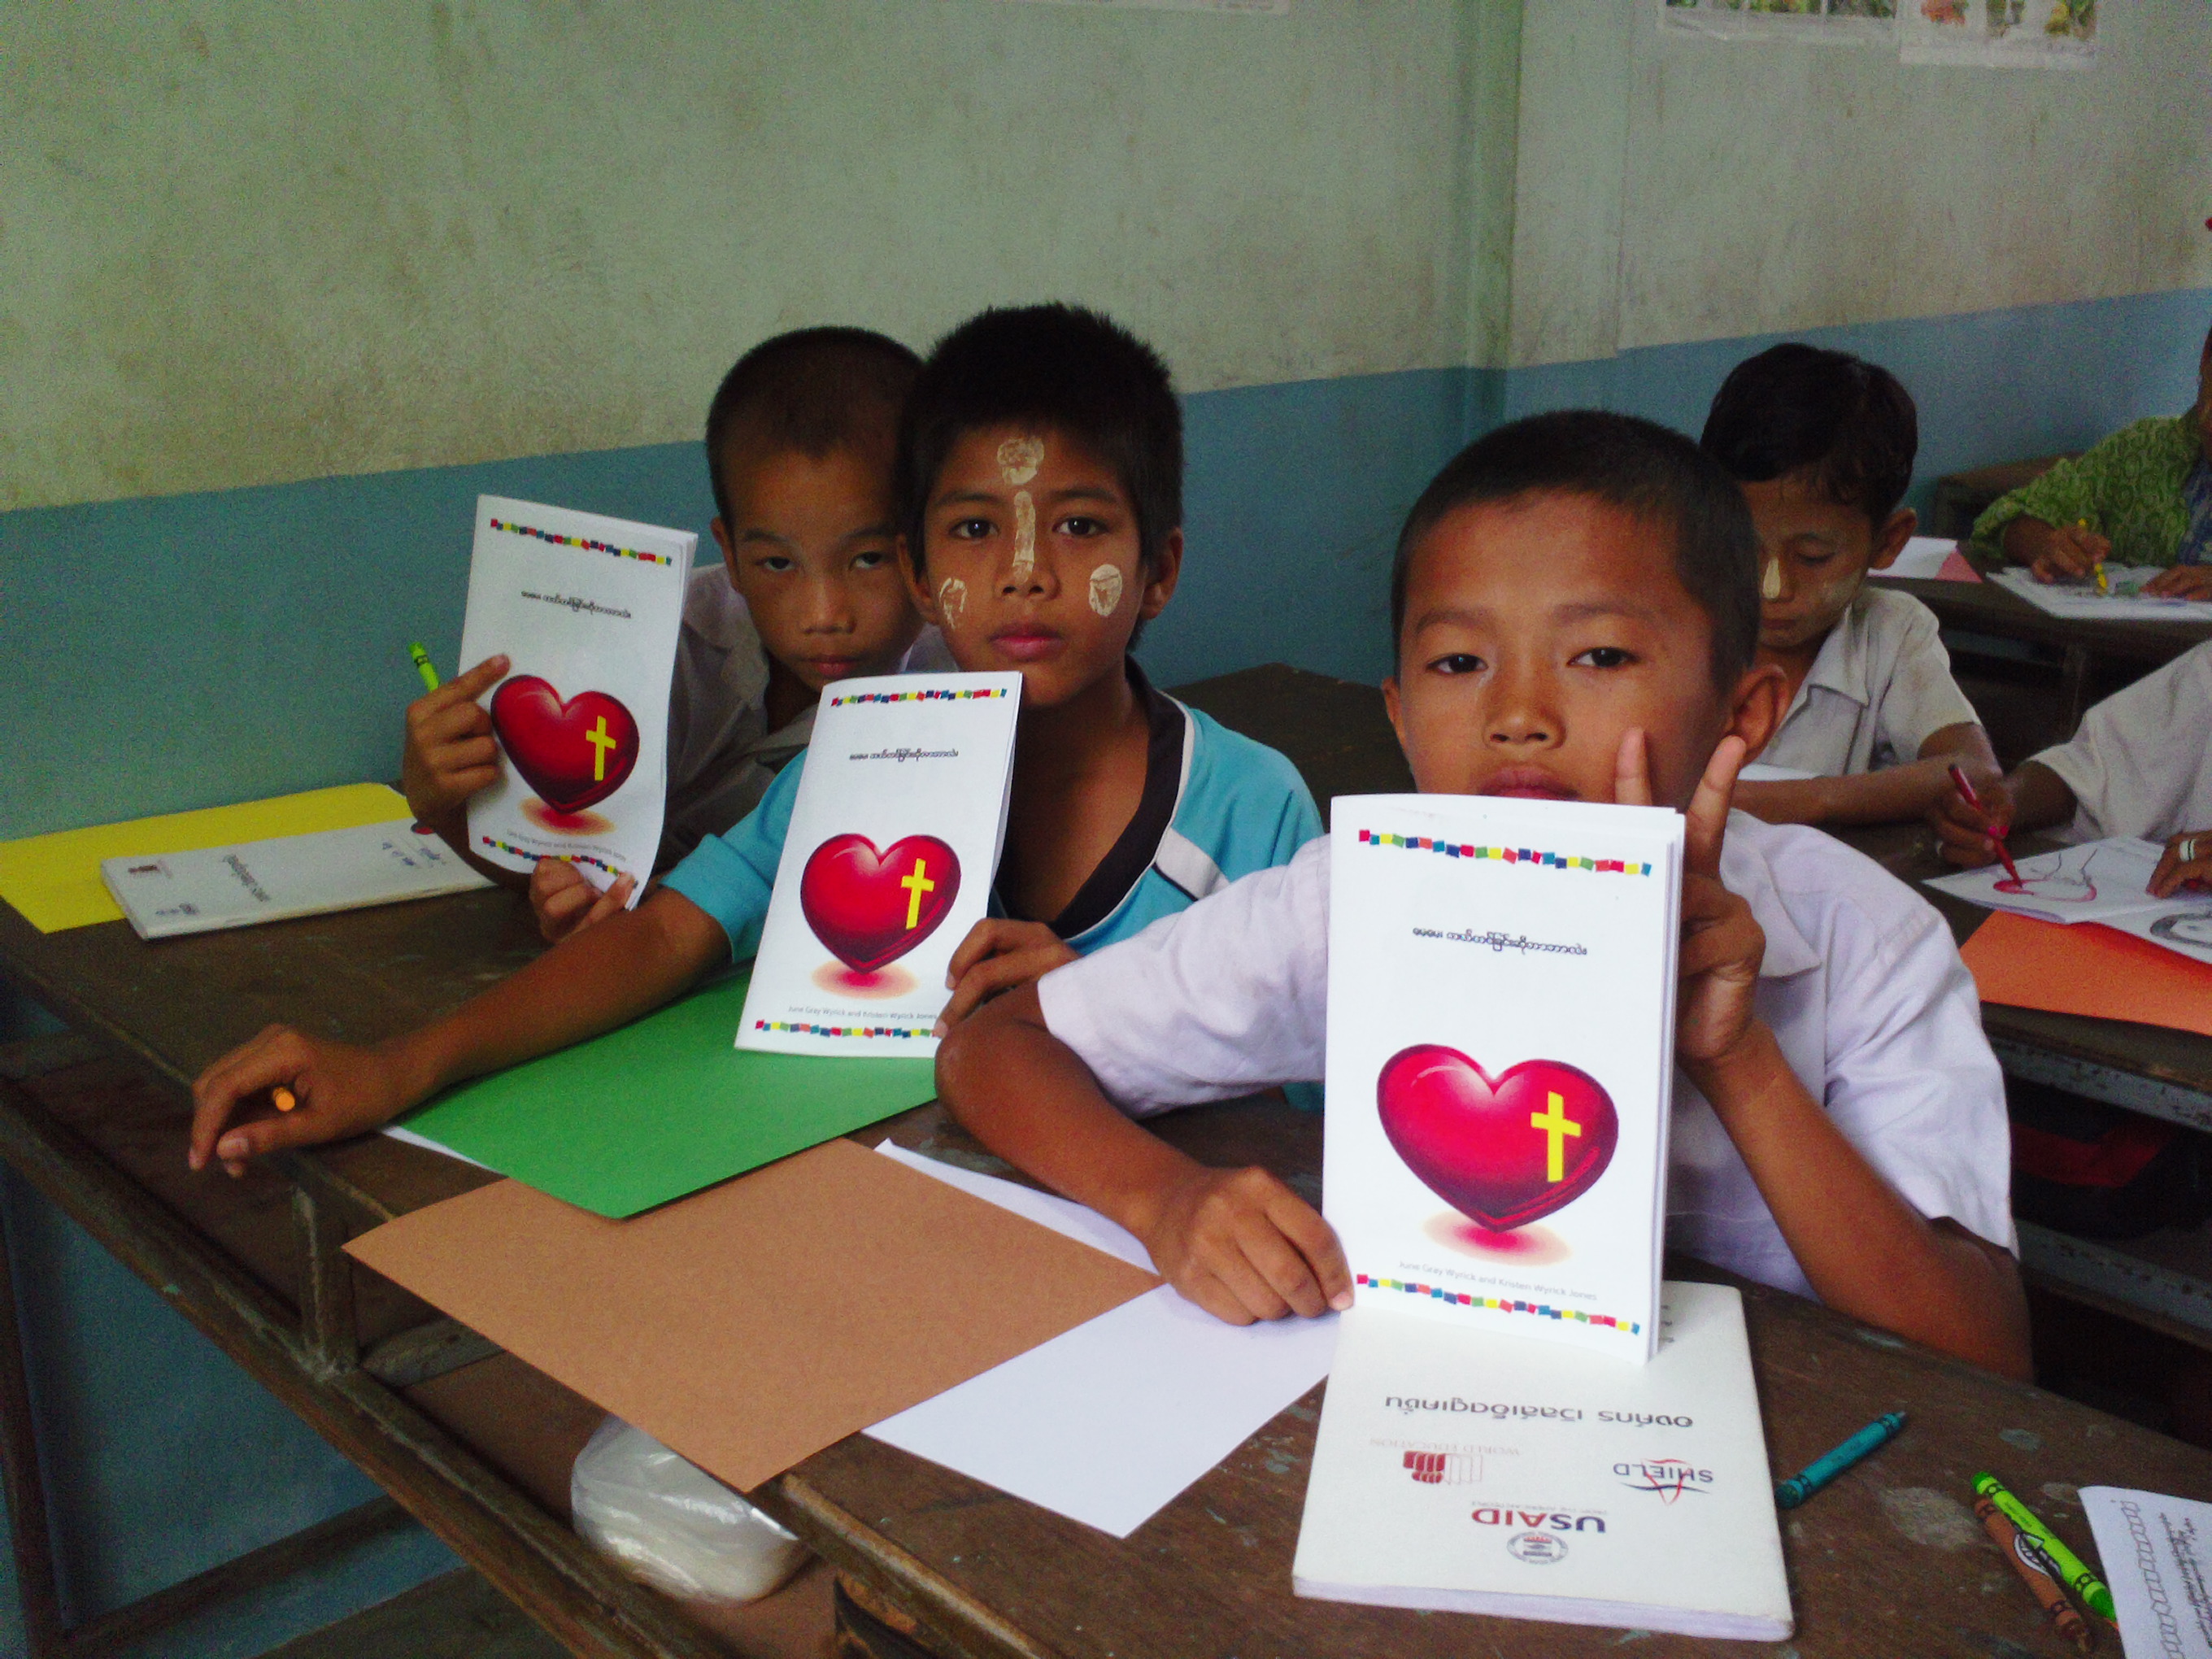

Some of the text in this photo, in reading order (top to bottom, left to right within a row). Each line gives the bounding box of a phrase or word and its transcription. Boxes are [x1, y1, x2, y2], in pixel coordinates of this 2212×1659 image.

[1478, 1275, 1497, 1284] and
[1613, 1463, 1714, 1484] SHIELD
[1471, 1507, 1607, 1534] USAID
